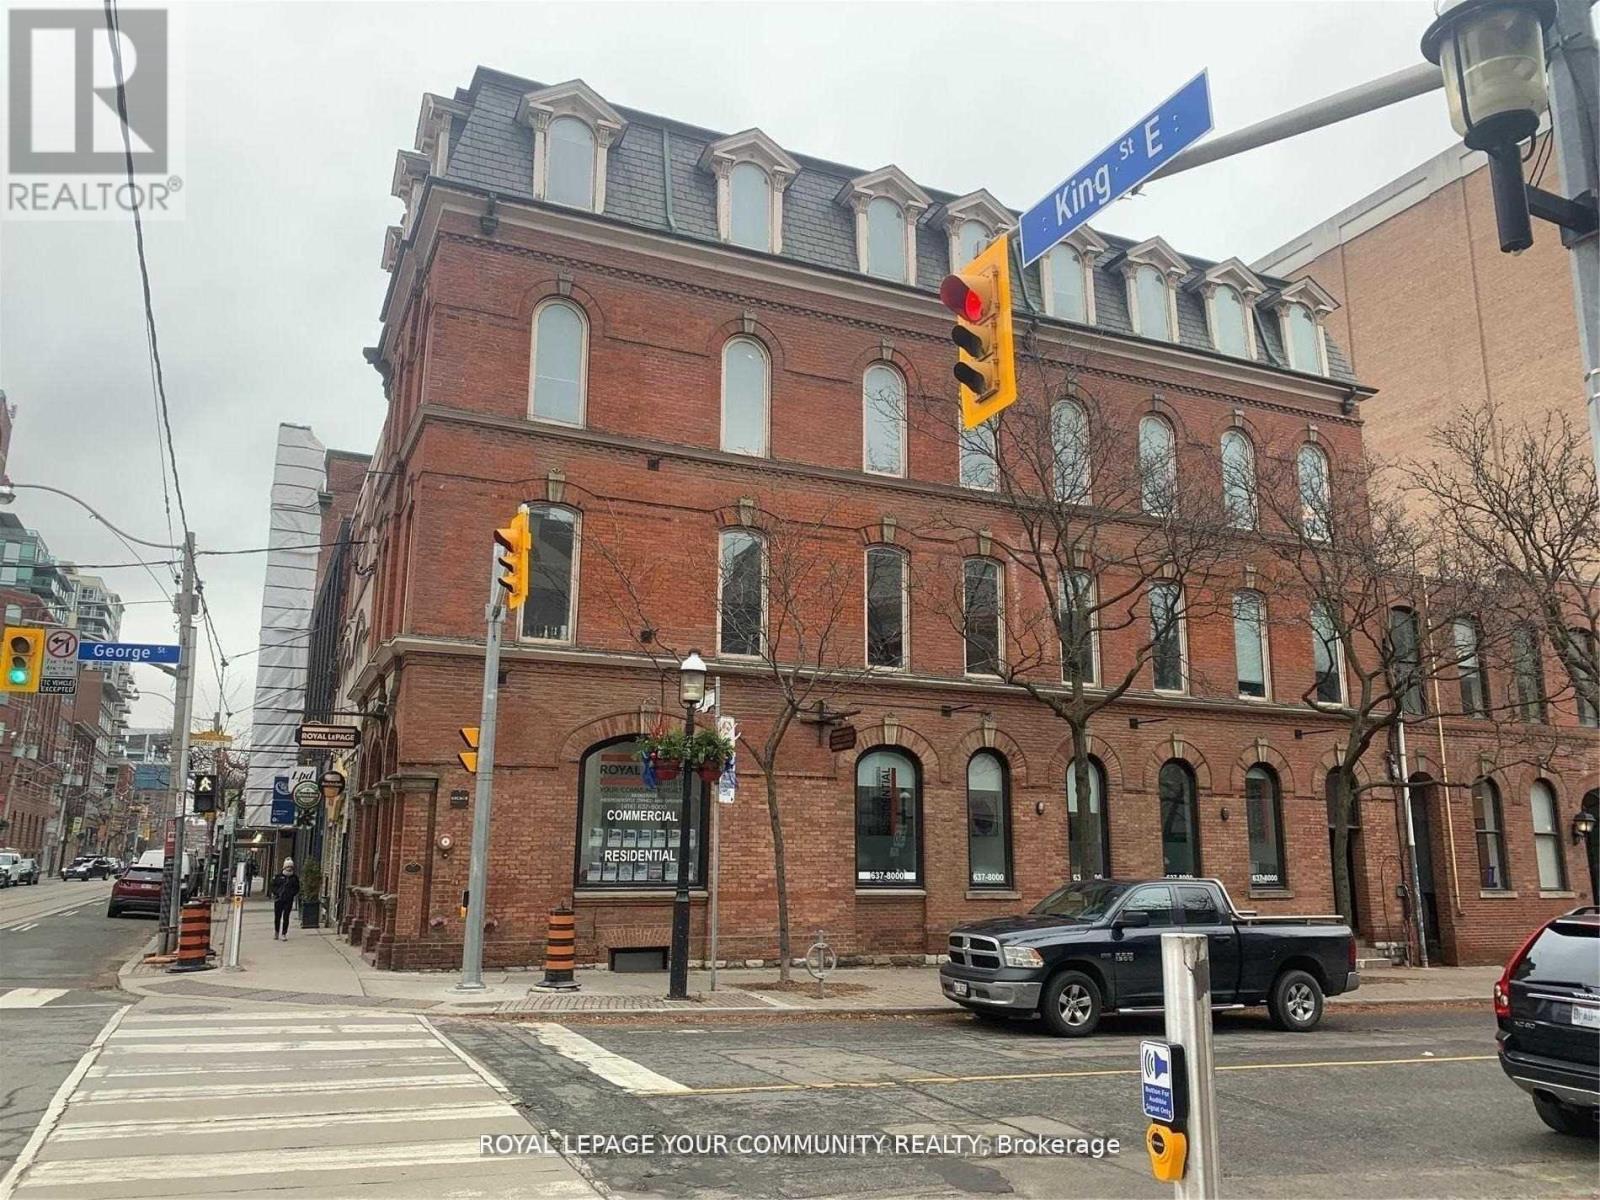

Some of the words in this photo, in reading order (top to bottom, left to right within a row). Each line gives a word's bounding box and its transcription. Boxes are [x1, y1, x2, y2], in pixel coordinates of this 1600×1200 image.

[1055, 164, 1111, 226] King
[1119, 137, 1134, 160] St
[1145, 114, 1163, 158] E
[94, 644, 150, 662] George
[157, 646, 166, 654] St
[301, 732, 326, 740] ROYAL
[600, 764, 641, 776] ROYAL
[607, 810, 678, 821] COMMERCIAL
[604, 849, 677, 861] RESIDENTIAL
[870, 871, 904, 880] 637-8000
[973, 873, 1004, 882] 637-8000
